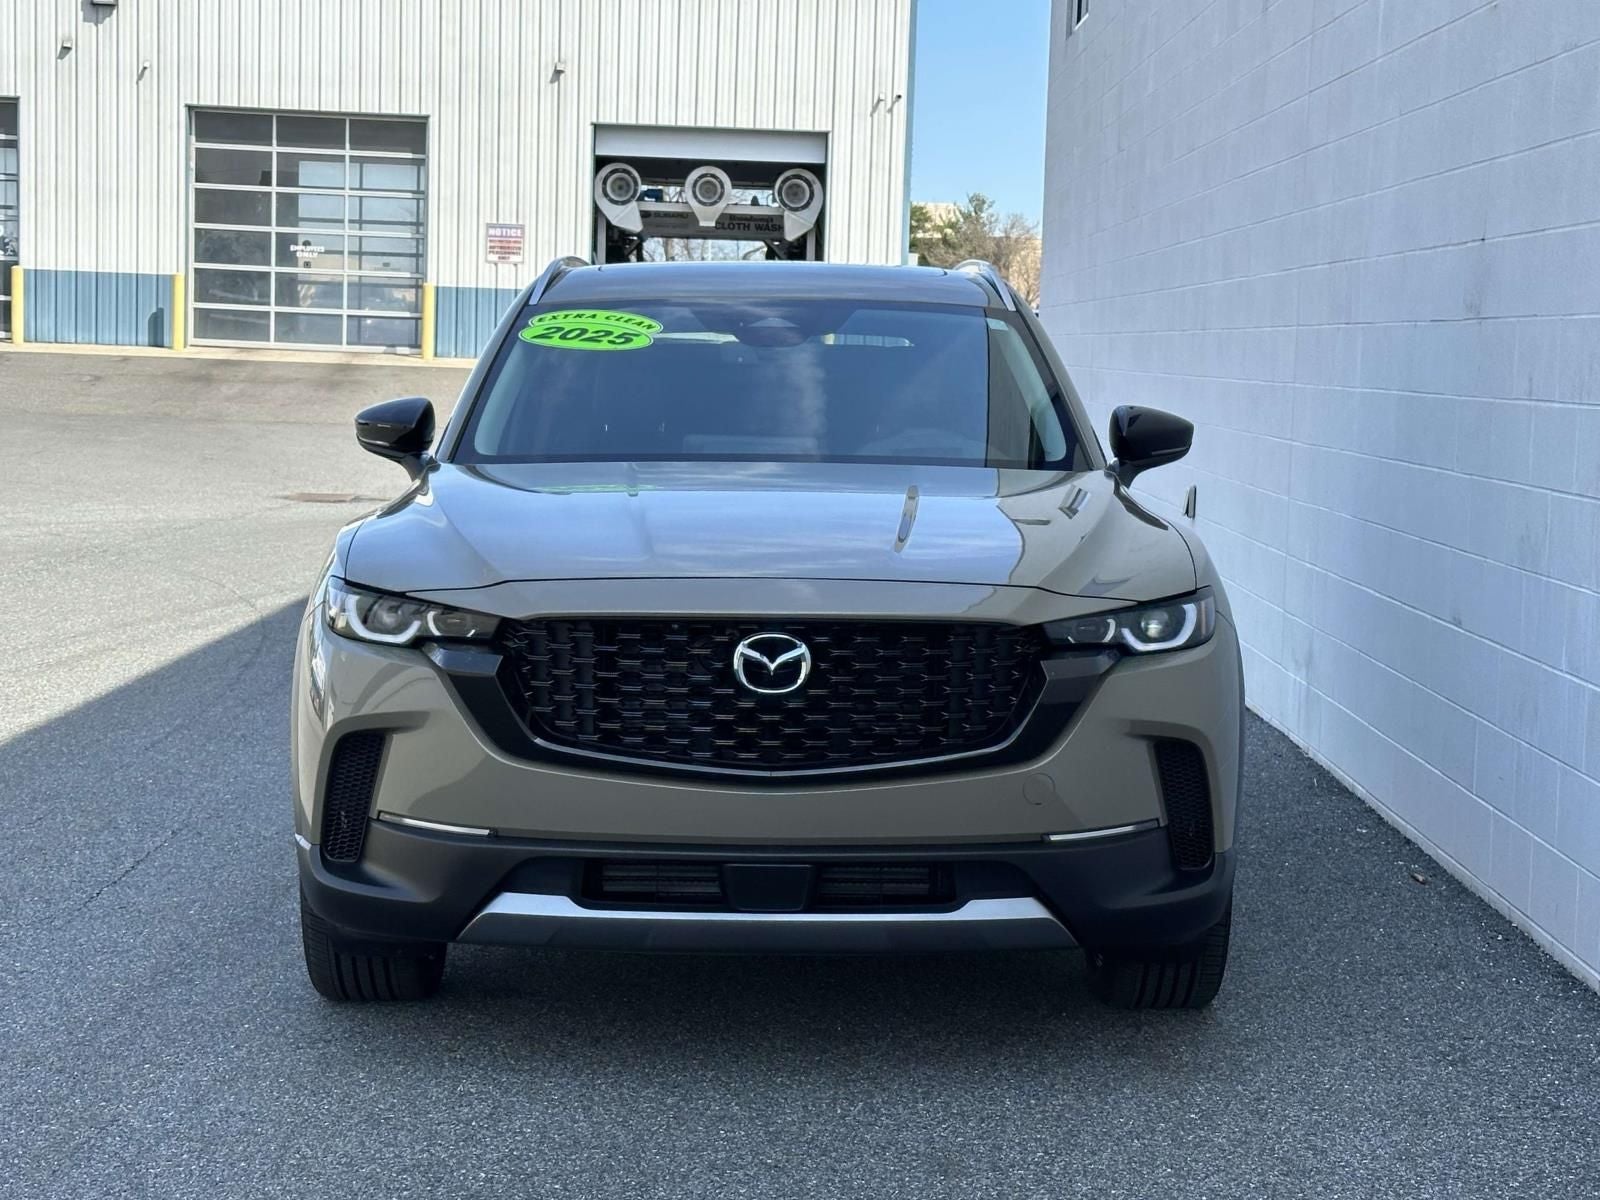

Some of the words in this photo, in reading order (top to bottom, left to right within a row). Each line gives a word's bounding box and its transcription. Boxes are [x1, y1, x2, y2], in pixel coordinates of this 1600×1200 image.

[488, 228, 521, 237] NOTICE
[715, 222, 750, 231] CLOTH
[538, 312, 598, 323] EXTRA
[604, 313, 657, 330] CLEAN
[530, 325, 642, 346] 2025
